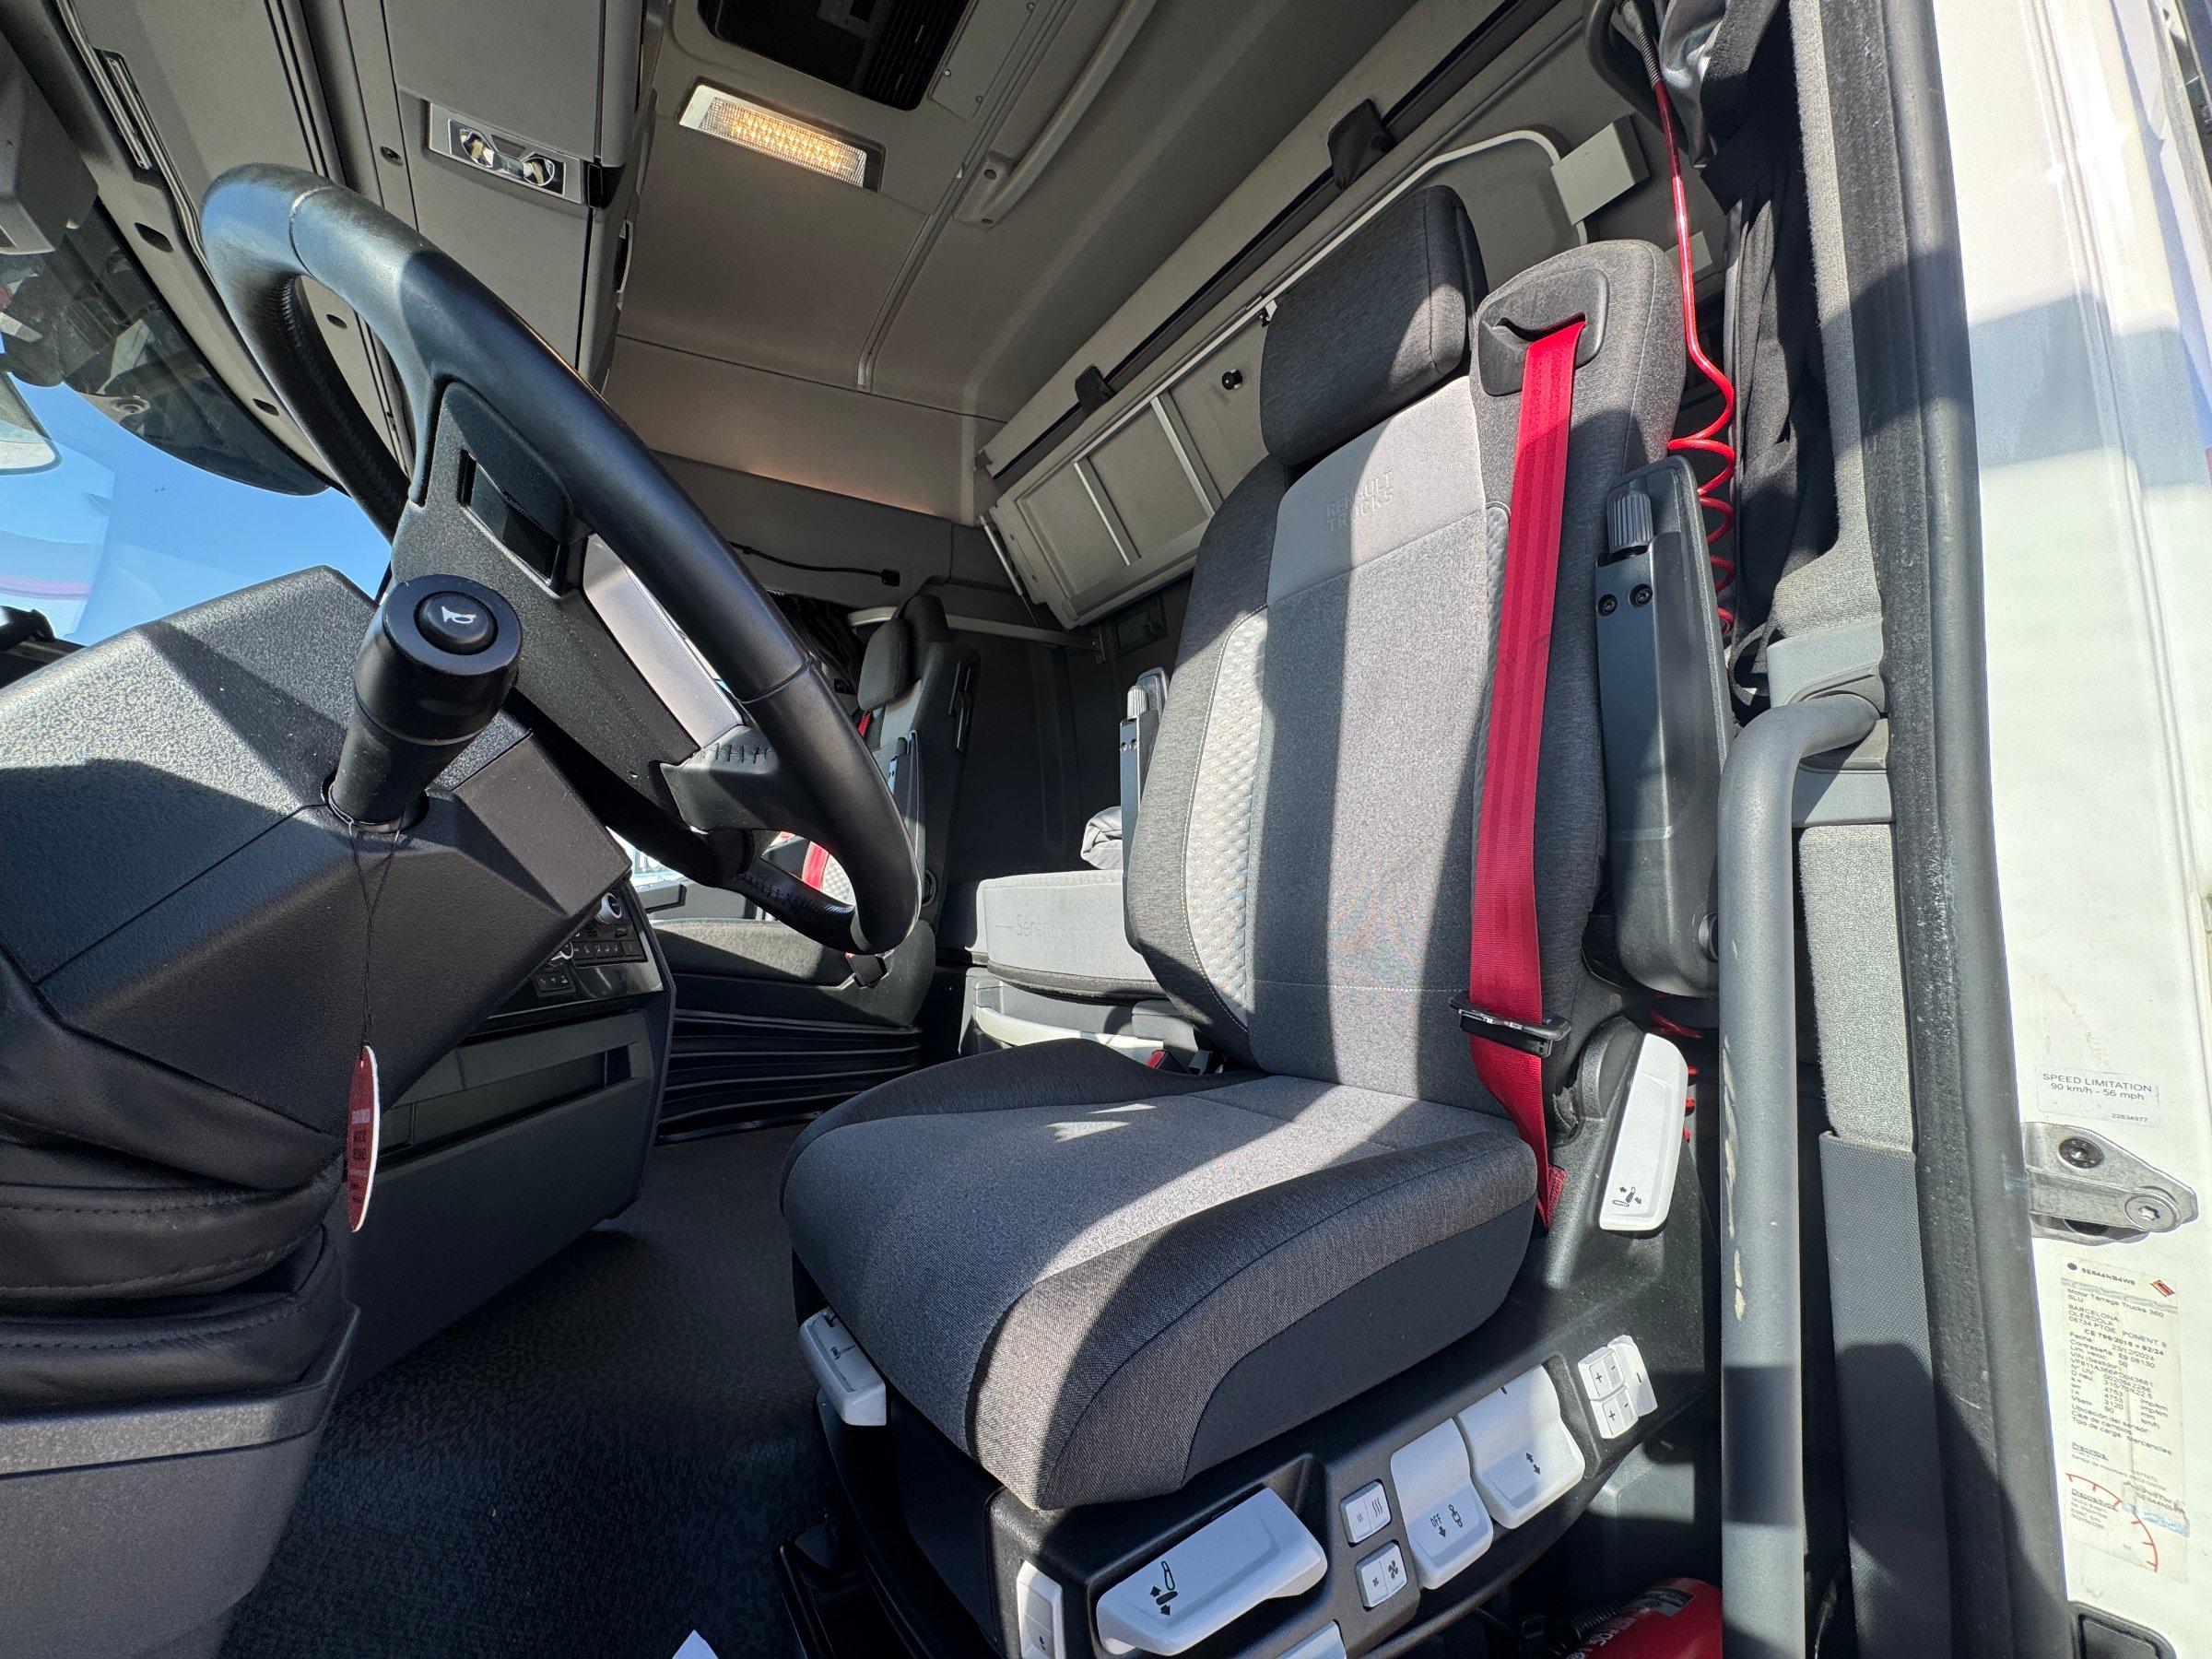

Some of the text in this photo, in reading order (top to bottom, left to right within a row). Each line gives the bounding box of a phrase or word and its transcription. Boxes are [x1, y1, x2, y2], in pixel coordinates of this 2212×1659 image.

[1328, 488, 1394, 533] TRUCKS
[2042, 1073, 2152, 1093] SPEED LIMITATION
[2051, 1082, 2064, 1090] 90
[2066, 1084, 2092, 1094] km/h
[2102, 1088, 2117, 1097] 56
[2120, 1092, 2145, 1101] mph
[2122, 1301, 2147, 1313] Trucks
[1430, 1512, 1443, 1528] OFF
